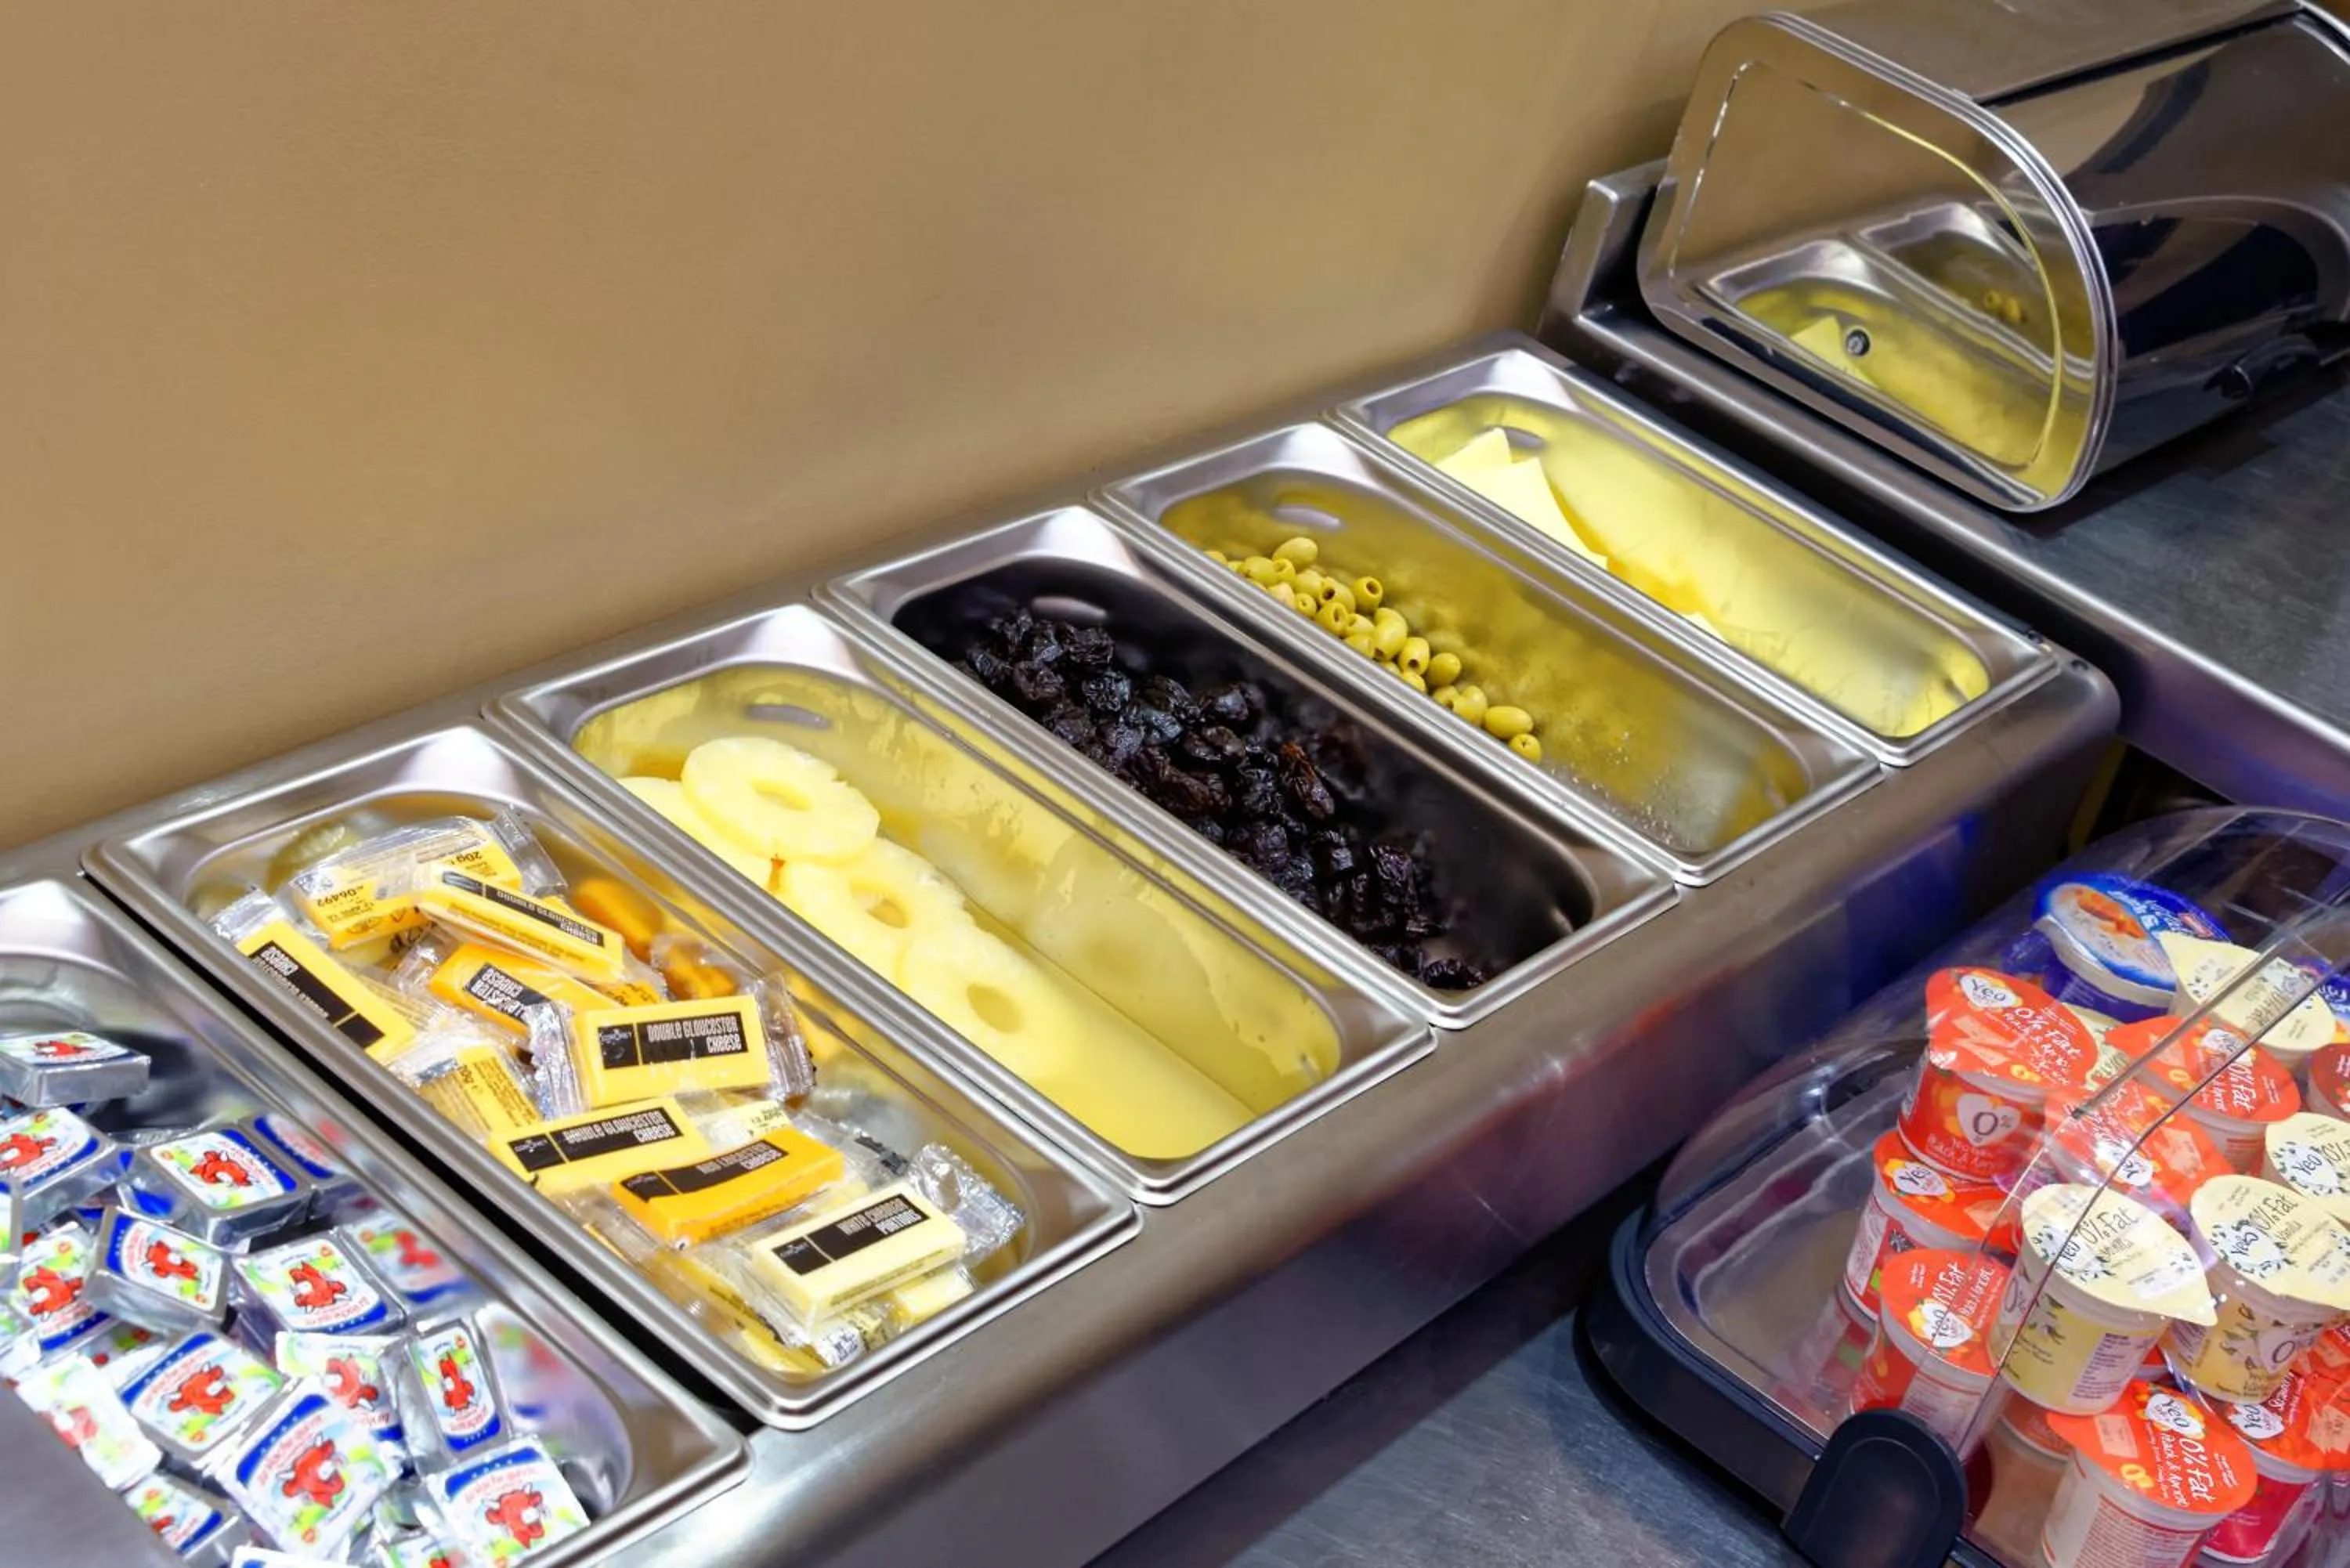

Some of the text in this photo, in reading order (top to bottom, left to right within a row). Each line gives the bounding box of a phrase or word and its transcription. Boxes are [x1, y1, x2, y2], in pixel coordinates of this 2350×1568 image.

[1971, 977, 2007, 1003] Yeo
[2291, 1154, 2323, 1176] Yeo
[2262, 1192, 2299, 1219] Fat
[2097, 1206, 2140, 1236] Fat
[2162, 1399, 2217, 1503] Yeo 0% Fat
